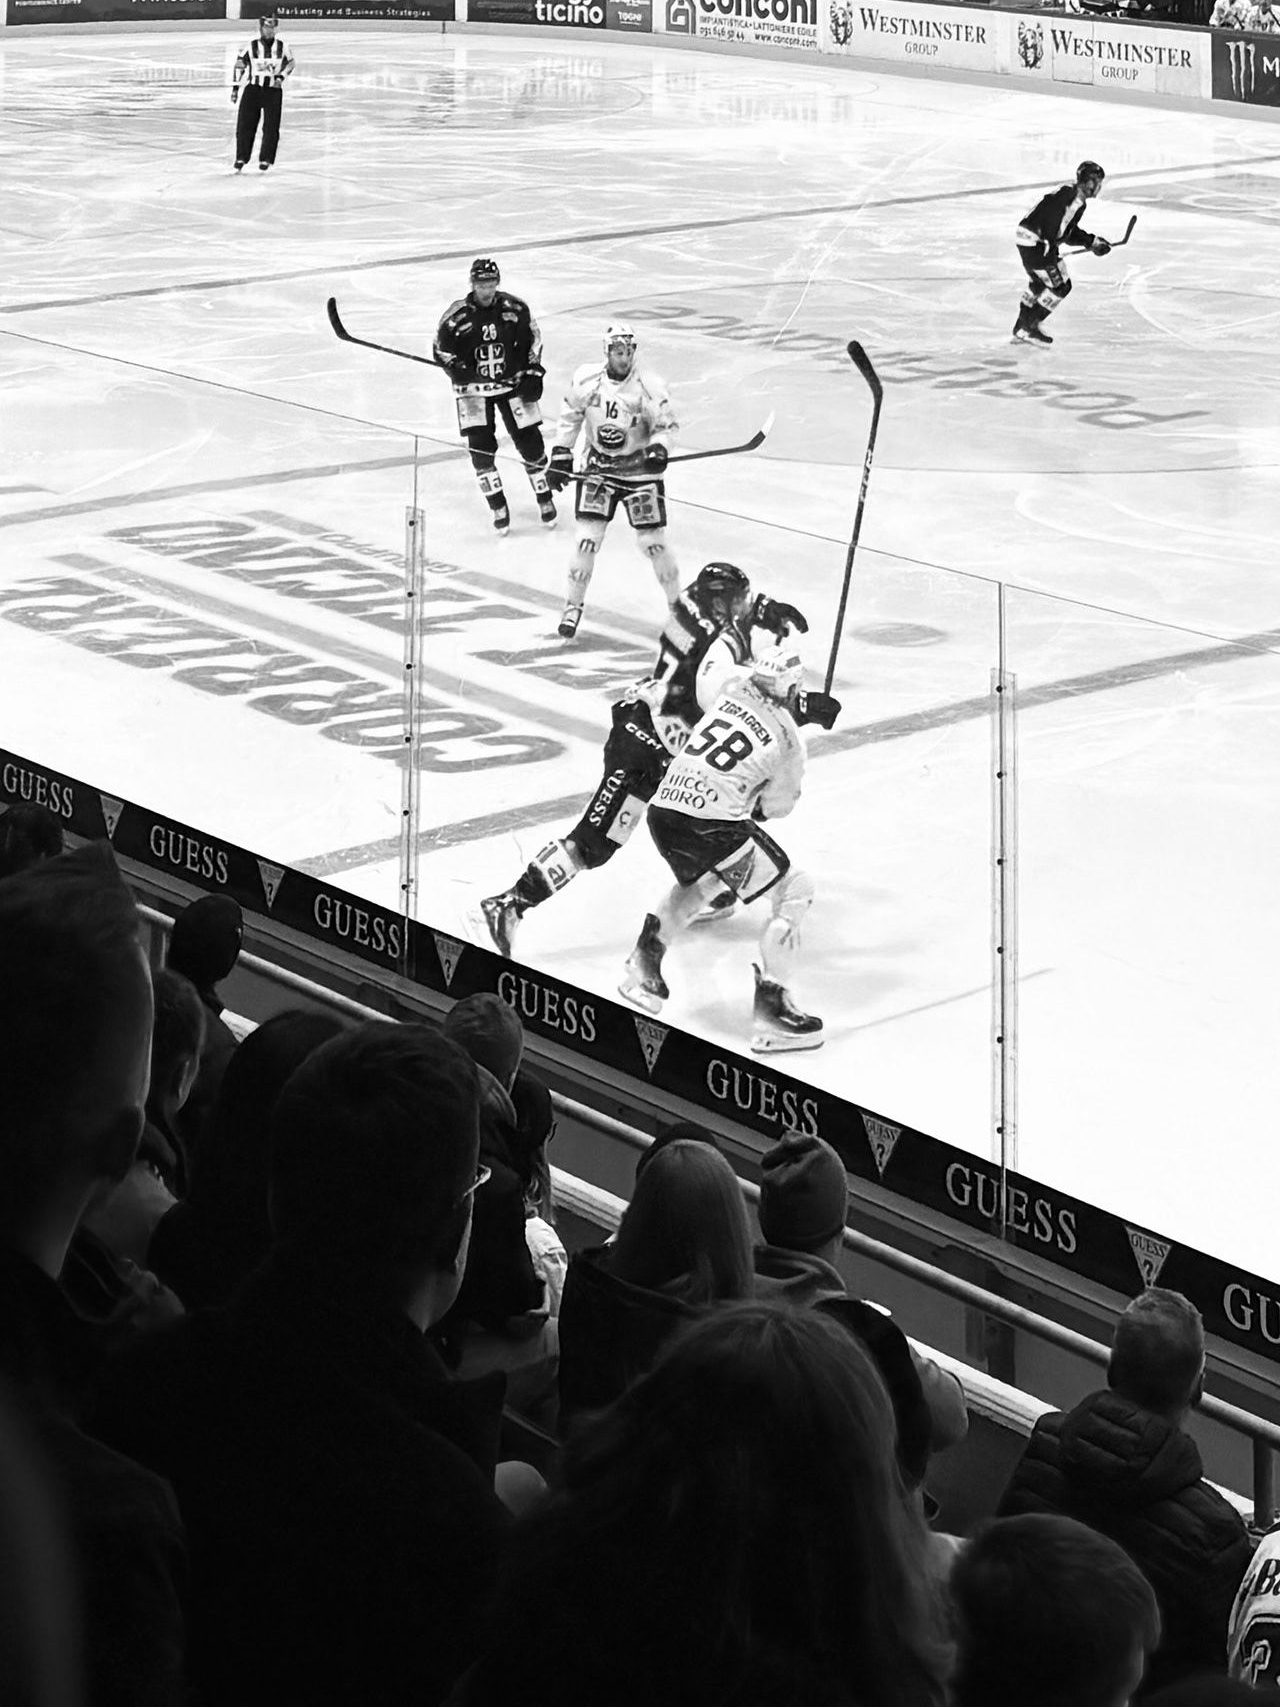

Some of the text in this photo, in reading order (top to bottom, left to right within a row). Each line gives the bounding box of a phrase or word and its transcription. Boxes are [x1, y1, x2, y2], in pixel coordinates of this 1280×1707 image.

[277, 7, 323, 17] Marketing
[345, 7, 383, 16] Business
[386, 8, 431, 18] Strategies
[905, 41, 939, 56] GROUP
[1101, 65, 1139, 81] GROUP
[606, 400, 618, 419] 16
[105, 519, 540, 637] TICINO
[625, 722, 662, 750] CCM
[684, 718, 754, 772] 58
[718, 700, 773, 747] ZGRAGGEN
[3, 763, 73, 819] GUESS
[589, 769, 626, 827] GUESS
[150, 824, 229, 884] GUESS
[314, 893, 401, 959] GUESS
[497, 971, 597, 1042] GUESS
[707, 1059, 819, 1139] GUESS
[946, 1162, 1077, 1254] GUESS
[1131, 1233, 1167, 1258] GUESS
